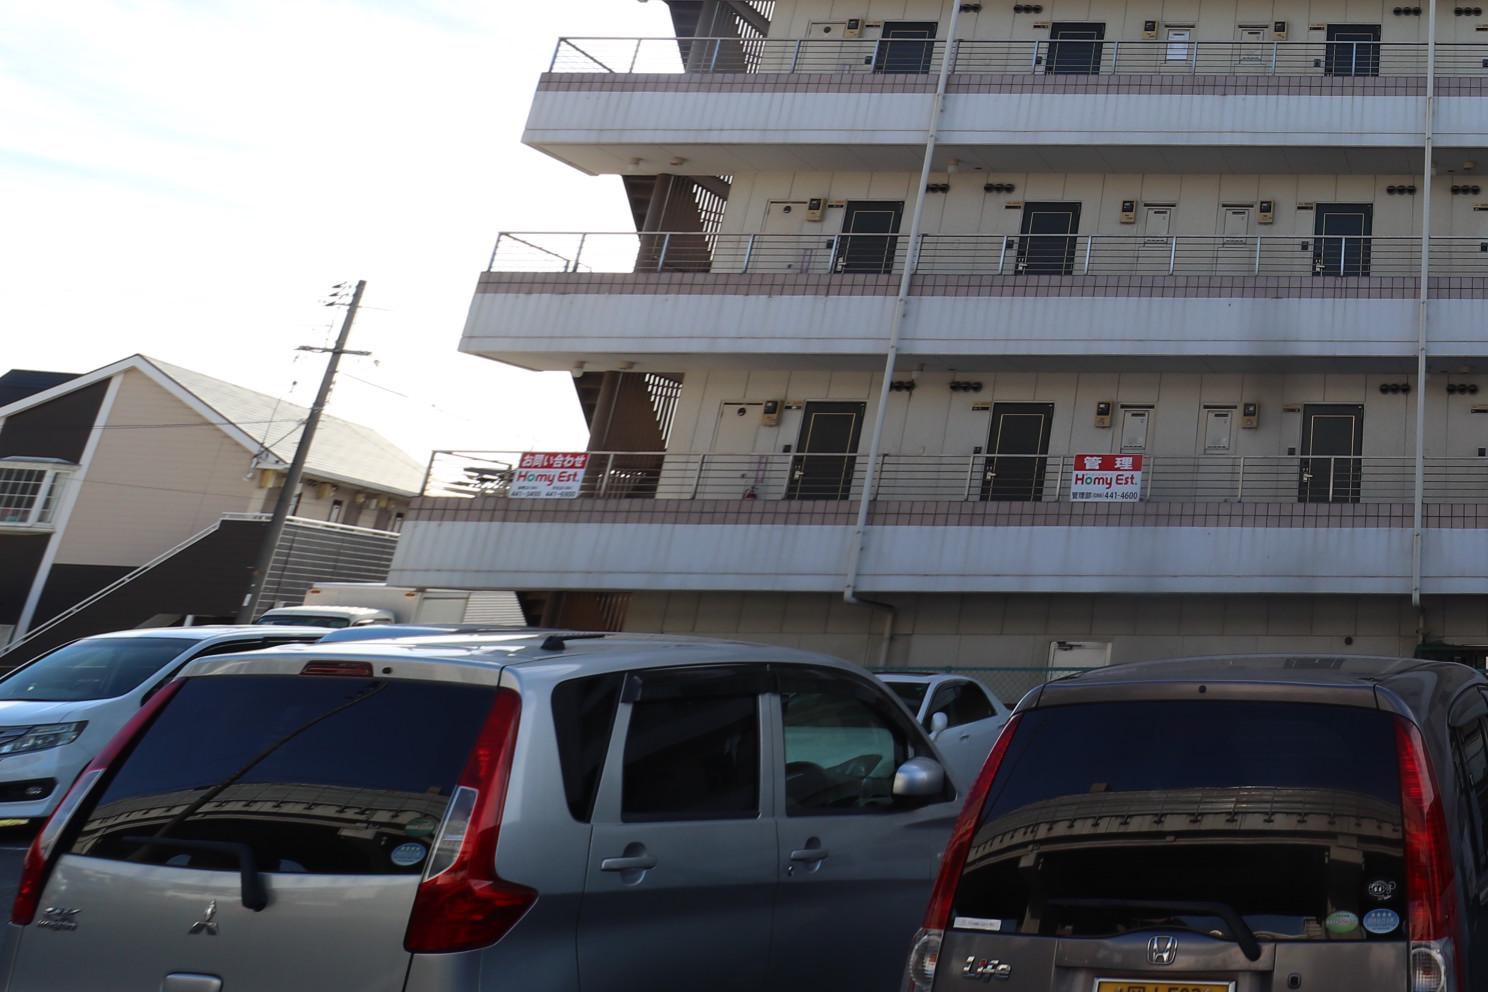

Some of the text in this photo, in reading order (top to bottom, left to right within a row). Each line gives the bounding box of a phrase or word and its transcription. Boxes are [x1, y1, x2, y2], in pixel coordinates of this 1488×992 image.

[521, 454, 586, 468] お問い合わせ
[1084, 456, 1133, 470] 管理
[516, 471, 556, 486] Homy
[1075, 474, 1112, 489] Homy
[963, 955, 1011, 979] Life
